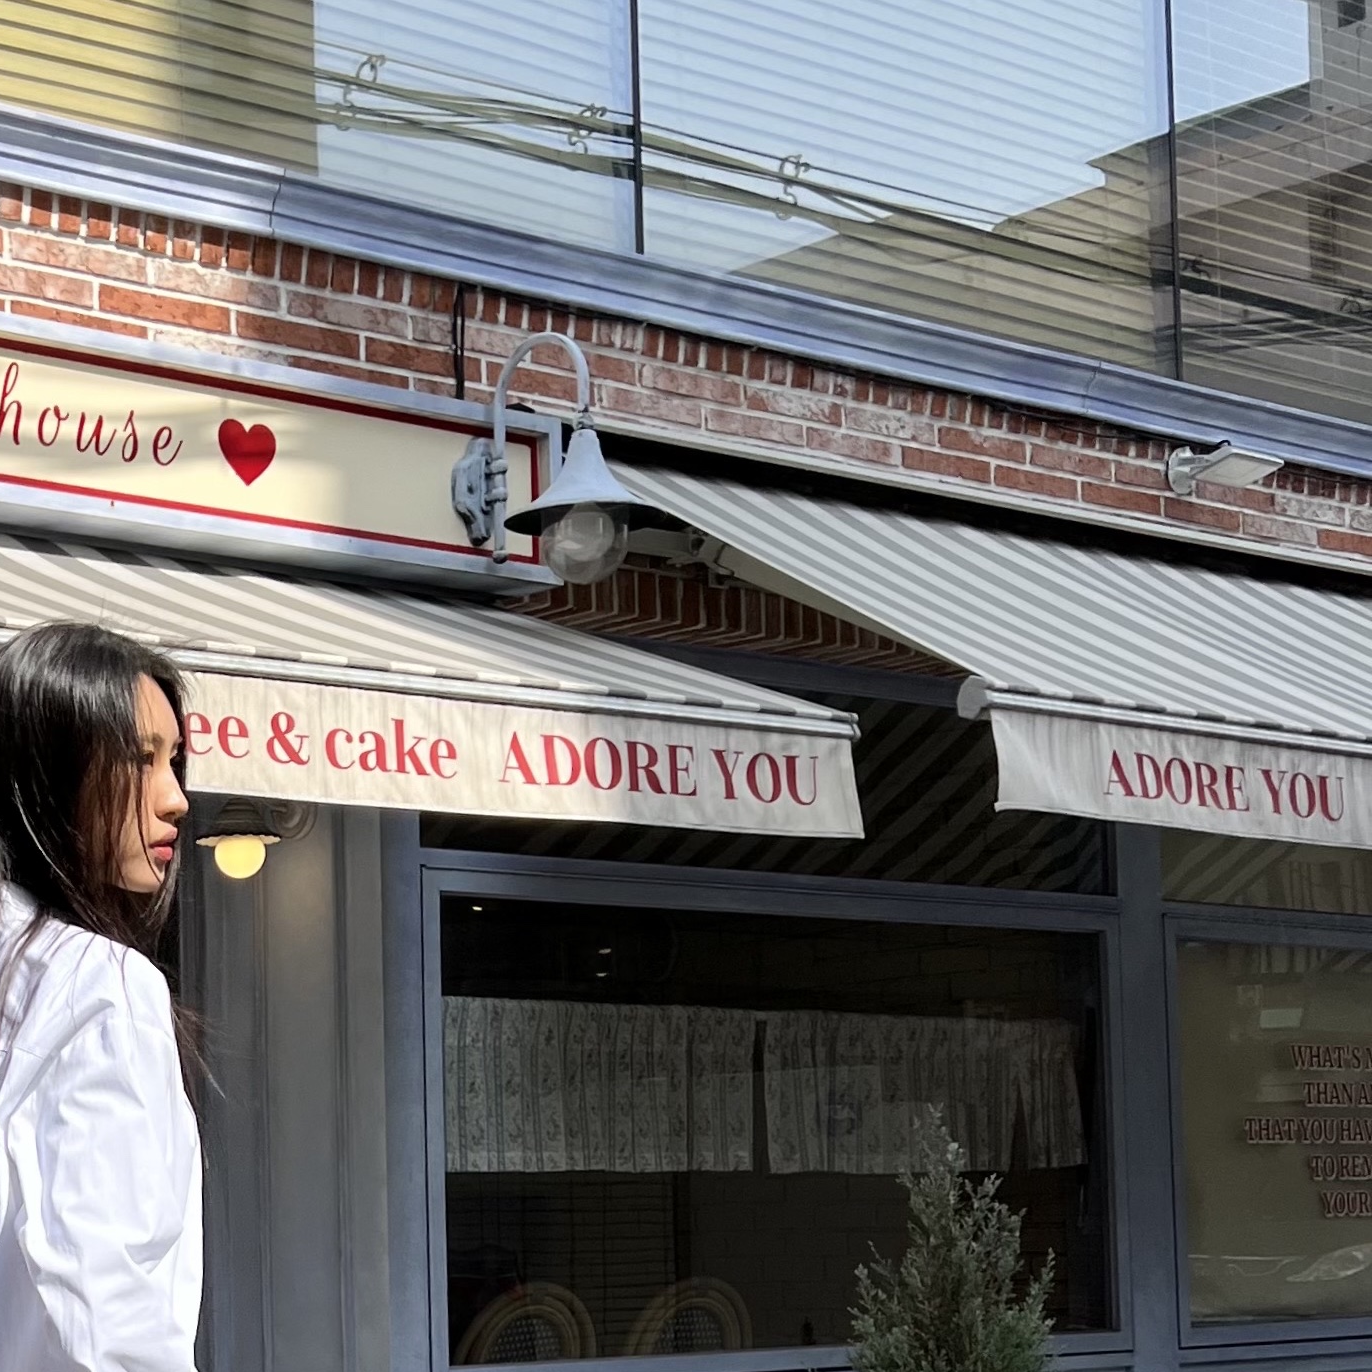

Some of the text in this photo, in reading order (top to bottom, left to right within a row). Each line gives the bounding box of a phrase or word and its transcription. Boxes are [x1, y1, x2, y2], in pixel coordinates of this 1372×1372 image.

[266, 711, 311, 767] &
[326, 717, 458, 781] cake
[499, 731, 698, 798] ADORE
[710, 749, 821, 807] YOU
[1103, 749, 1345, 823] ADORE YOU
[1291, 1044, 1361, 1072] WHAT'S
[1303, 1081, 1355, 1107] THAN
[1244, 1117, 1298, 1144] THAT
[1297, 1118, 1337, 1144] YOU
[1310, 1154, 1338, 1181] TO
[1320, 1191, 1372, 1219] YOUR
